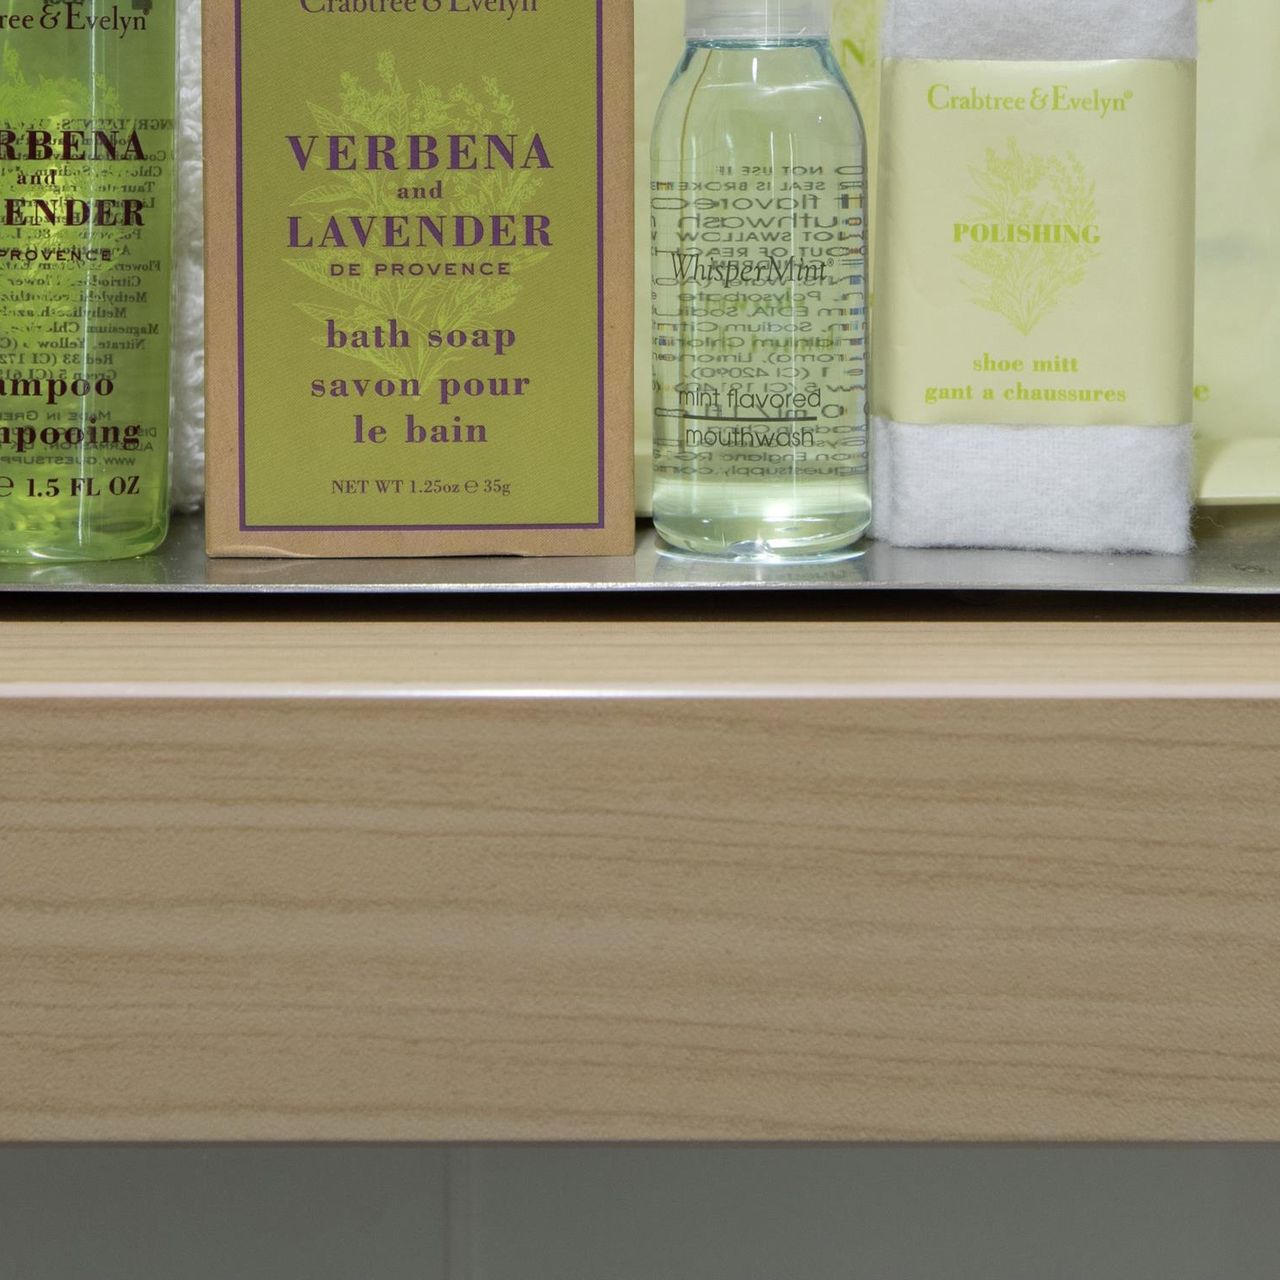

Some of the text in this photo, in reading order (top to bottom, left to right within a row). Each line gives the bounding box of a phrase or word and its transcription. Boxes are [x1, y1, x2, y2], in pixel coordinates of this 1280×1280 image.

[39, 8, 61, 30] &
[927, 83, 1026, 112] Crabtree
[1029, 86, 1049, 111] &
[285, 133, 554, 171] VERBENA
[16, 169, 56, 185] and
[397, 180, 443, 199] and
[286, 215, 553, 248] LAVENDER
[952, 222, 1101, 245] POLISHING
[331, 262, 511, 277] DE PROVENCE
[325, 319, 516, 355] bath soap
[972, 353, 1079, 373] shoe mitt
[310, 376, 530, 405] savon pour
[679, 388, 718, 407] mint
[727, 387, 821, 409] flavored
[925, 382, 972, 404] gant
[1003, 382, 1127, 403] chaussures
[353, 414, 488, 444] le bain
[686, 428, 814, 447] mouthwash
[27, 478, 60, 497] 1.5
[70, 477, 100, 496] FL
[109, 475, 140, 496] OZ
[331, 480, 369, 494] NET
[375, 480, 403, 494] WT
[410, 480, 459, 494] 1.25oz
[484, 480, 511, 496] 35g
